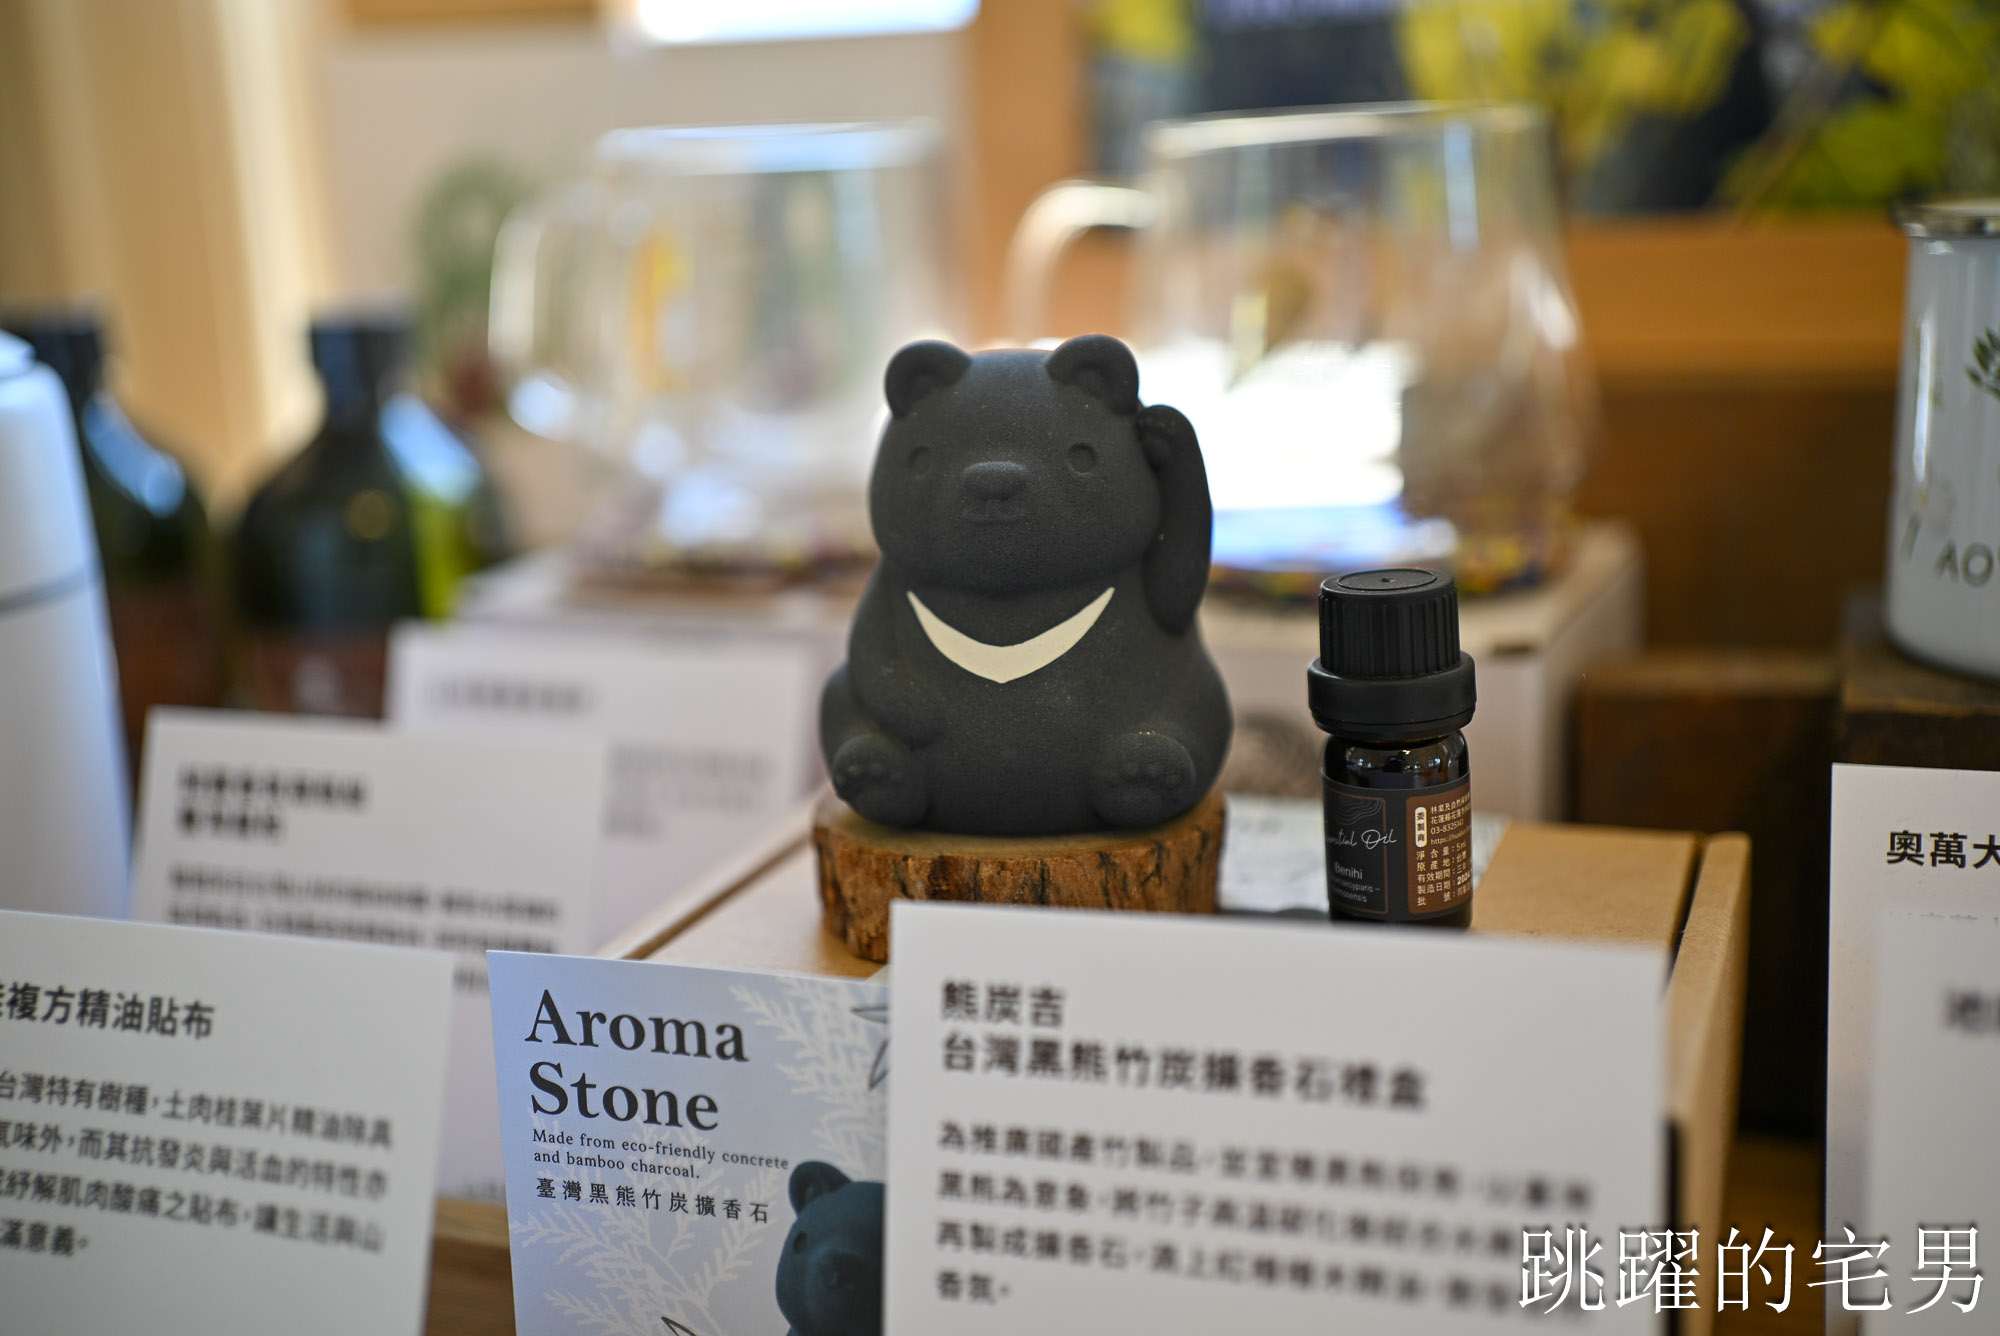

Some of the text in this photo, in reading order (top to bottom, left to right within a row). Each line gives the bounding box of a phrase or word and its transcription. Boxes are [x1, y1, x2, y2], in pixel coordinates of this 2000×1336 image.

[1934, 541, 2000, 588] AO
[1886, 830, 2000, 869] 奧萬大
[0, 981, 214, 1040] 複方精油貼布
[525, 989, 750, 1062] Aroma
[942, 1030, 1428, 1111] 台灣黑熊竹炭擴香石禮盒
[529, 1061, 718, 1131] Stone
[532, 1129, 789, 1170] Made from eco-friendly concrete
[534, 1151, 700, 1178] and bamboo charcoal.
[536, 1178, 769, 1224] 臺灣黑熊竹炭擴香石
